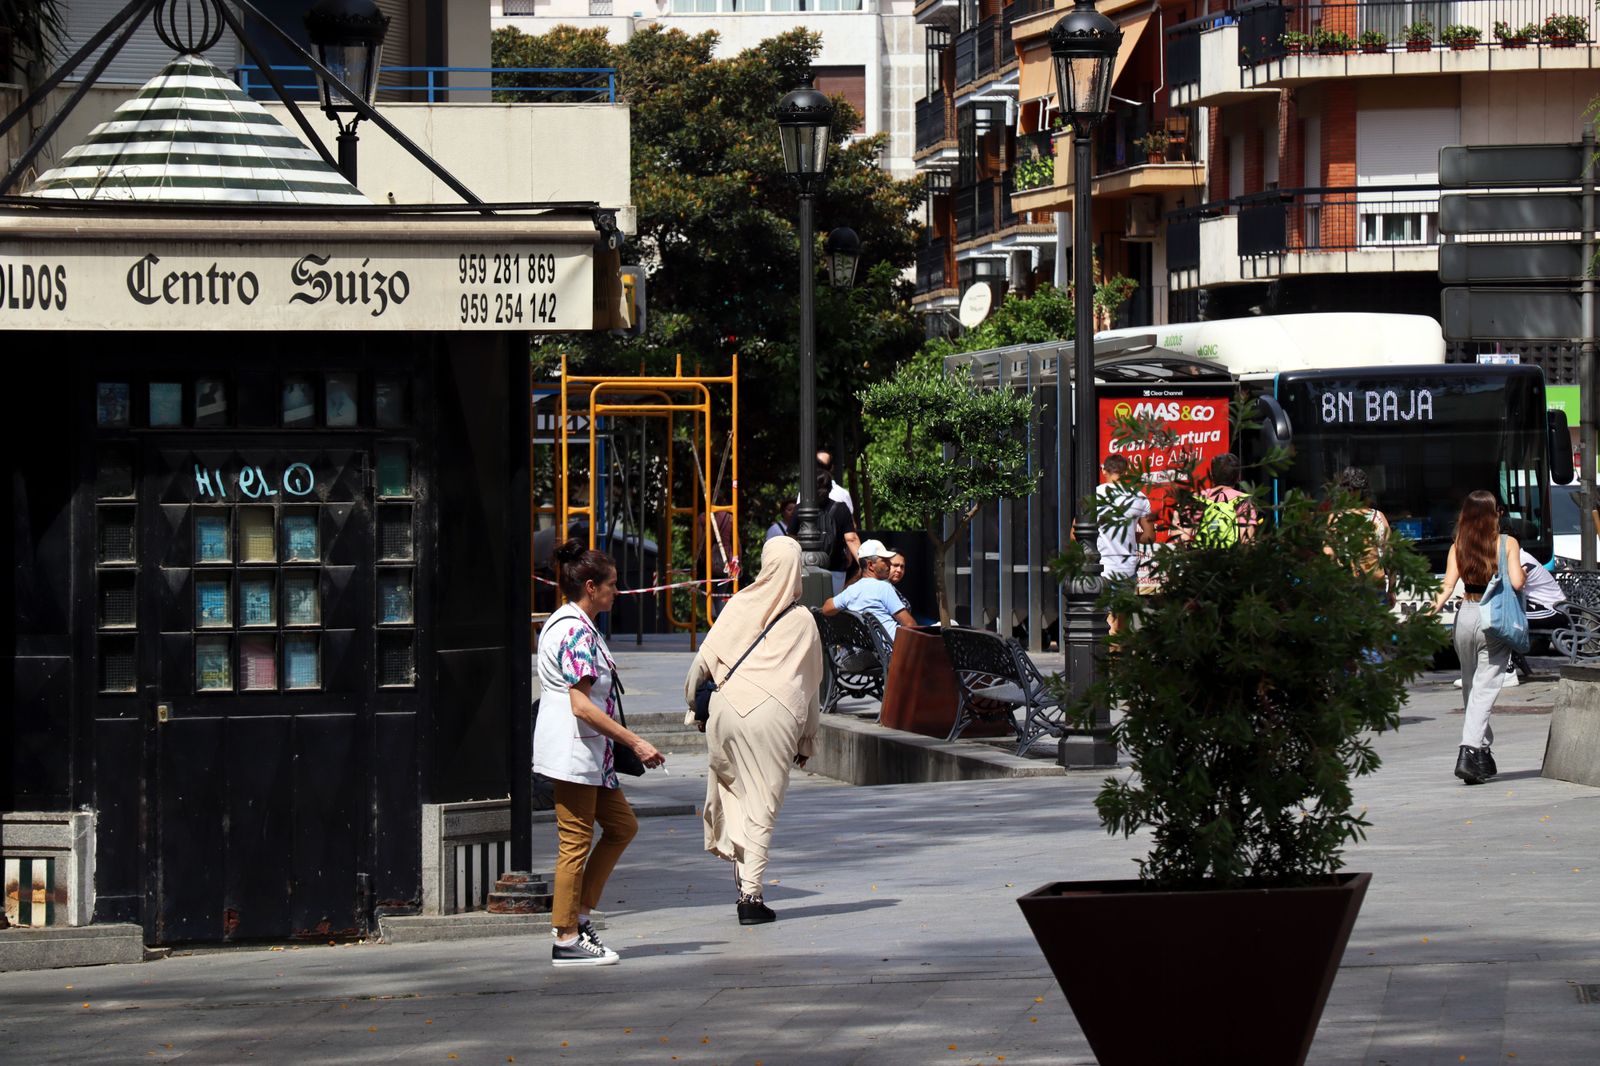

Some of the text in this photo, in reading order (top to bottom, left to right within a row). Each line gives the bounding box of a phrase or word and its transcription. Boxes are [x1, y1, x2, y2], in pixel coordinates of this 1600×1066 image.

[459, 253, 555, 284] 959 281 869
[127, 253, 409, 316] Centro Suizo
[461, 293, 557, 323] 959 254 142
[1132, 402, 1215, 421] MAS&GO
[1321, 389, 1432, 422] 8N BAJA
